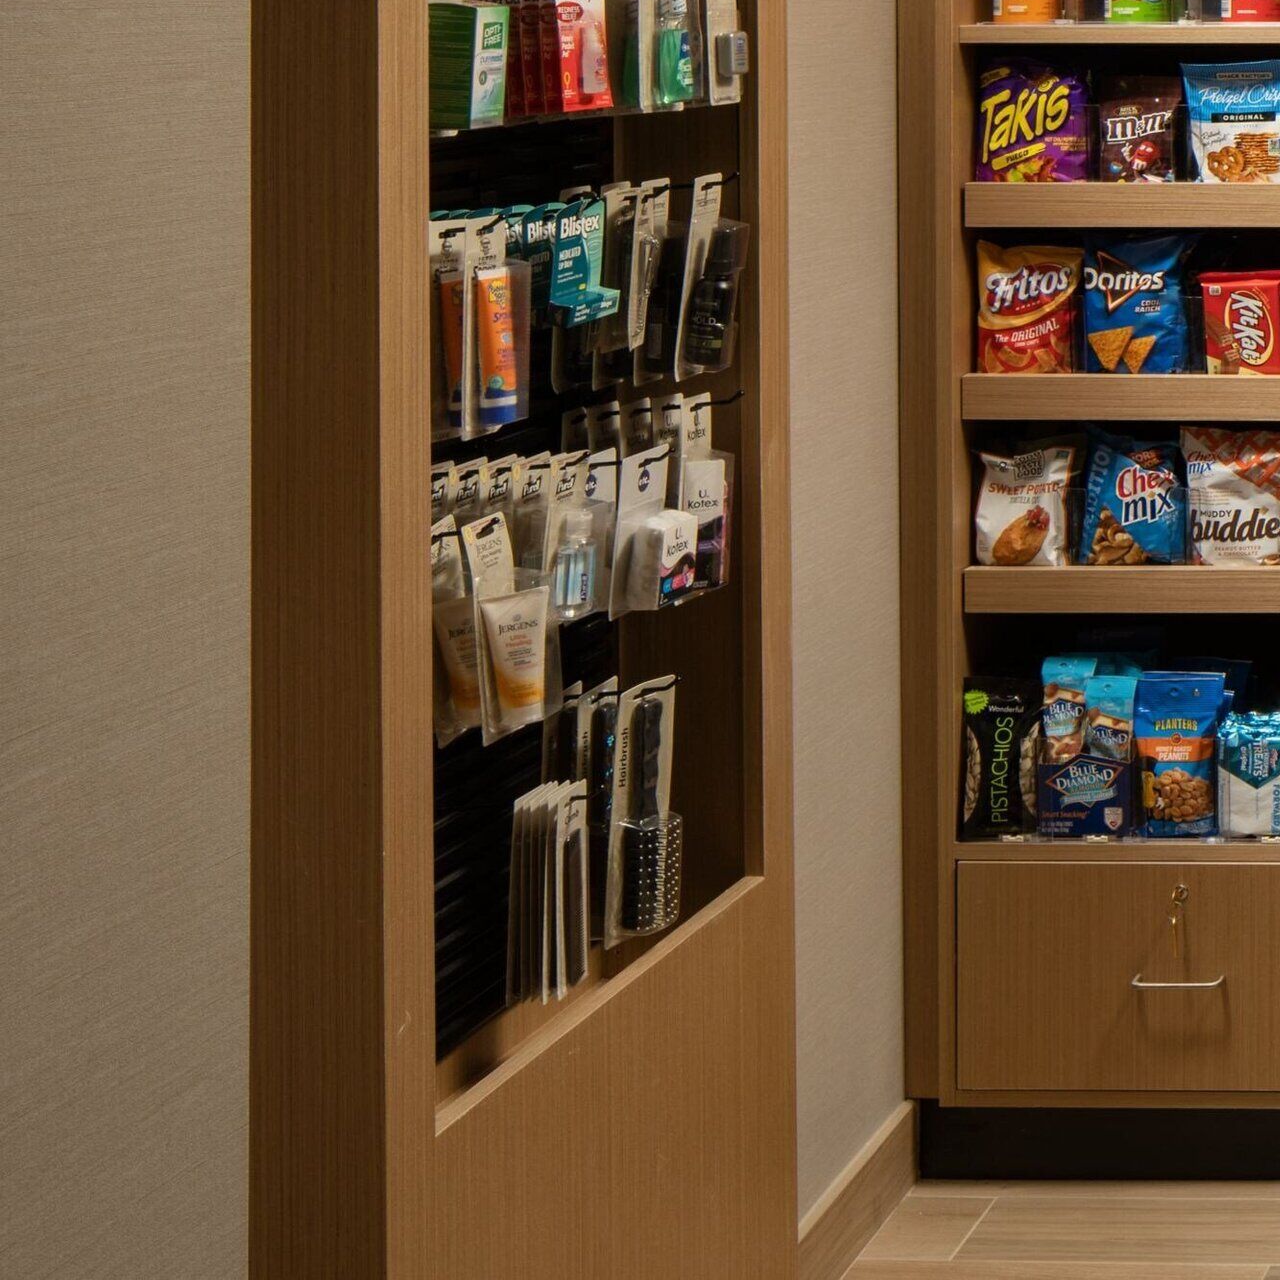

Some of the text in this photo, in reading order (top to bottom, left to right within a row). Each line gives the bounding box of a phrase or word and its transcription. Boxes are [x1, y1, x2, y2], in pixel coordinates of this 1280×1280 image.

[483, 23, 502, 38] OPTI-
[483, 33, 503, 48] FREE
[1198, 87, 1244, 110] Pretzel
[1222, 113, 1264, 122] ORIGINAL
[560, 214, 600, 240] Blistex
[558, 246, 582, 260] MEDICATED
[1084, 267, 1166, 292] Doritos
[985, 266, 1071, 313] Fritos
[995, 317, 1060, 344] The ORIGINAL
[1230, 291, 1265, 365] Kit Kat
[687, 427, 706, 442] kotex
[1187, 451, 1217, 463] Chex
[1188, 461, 1216, 475] mix
[988, 482, 1025, 496] SWEET
[1117, 467, 1175, 498] Chex
[687, 496, 719, 510] kotex
[1122, 488, 1174, 524] mix
[1200, 509, 1233, 519] MUDDY
[666, 539, 689, 557] kotex
[499, 620, 538, 635] JERGENS
[988, 705, 1025, 714] Wonderful
[1049, 702, 1072, 715] BLUE
[1155, 718, 1198, 732] PLANTERS
[618, 727, 629, 789] Hairbrush
[1253, 741, 1264, 778] TREATS
[991, 716, 1014, 823] PISTACHIOS
[1069, 764, 1099, 778] BLUE
[1056, 769, 1115, 790] DIAMOND
[1273, 784, 1280, 827] FORWARD
